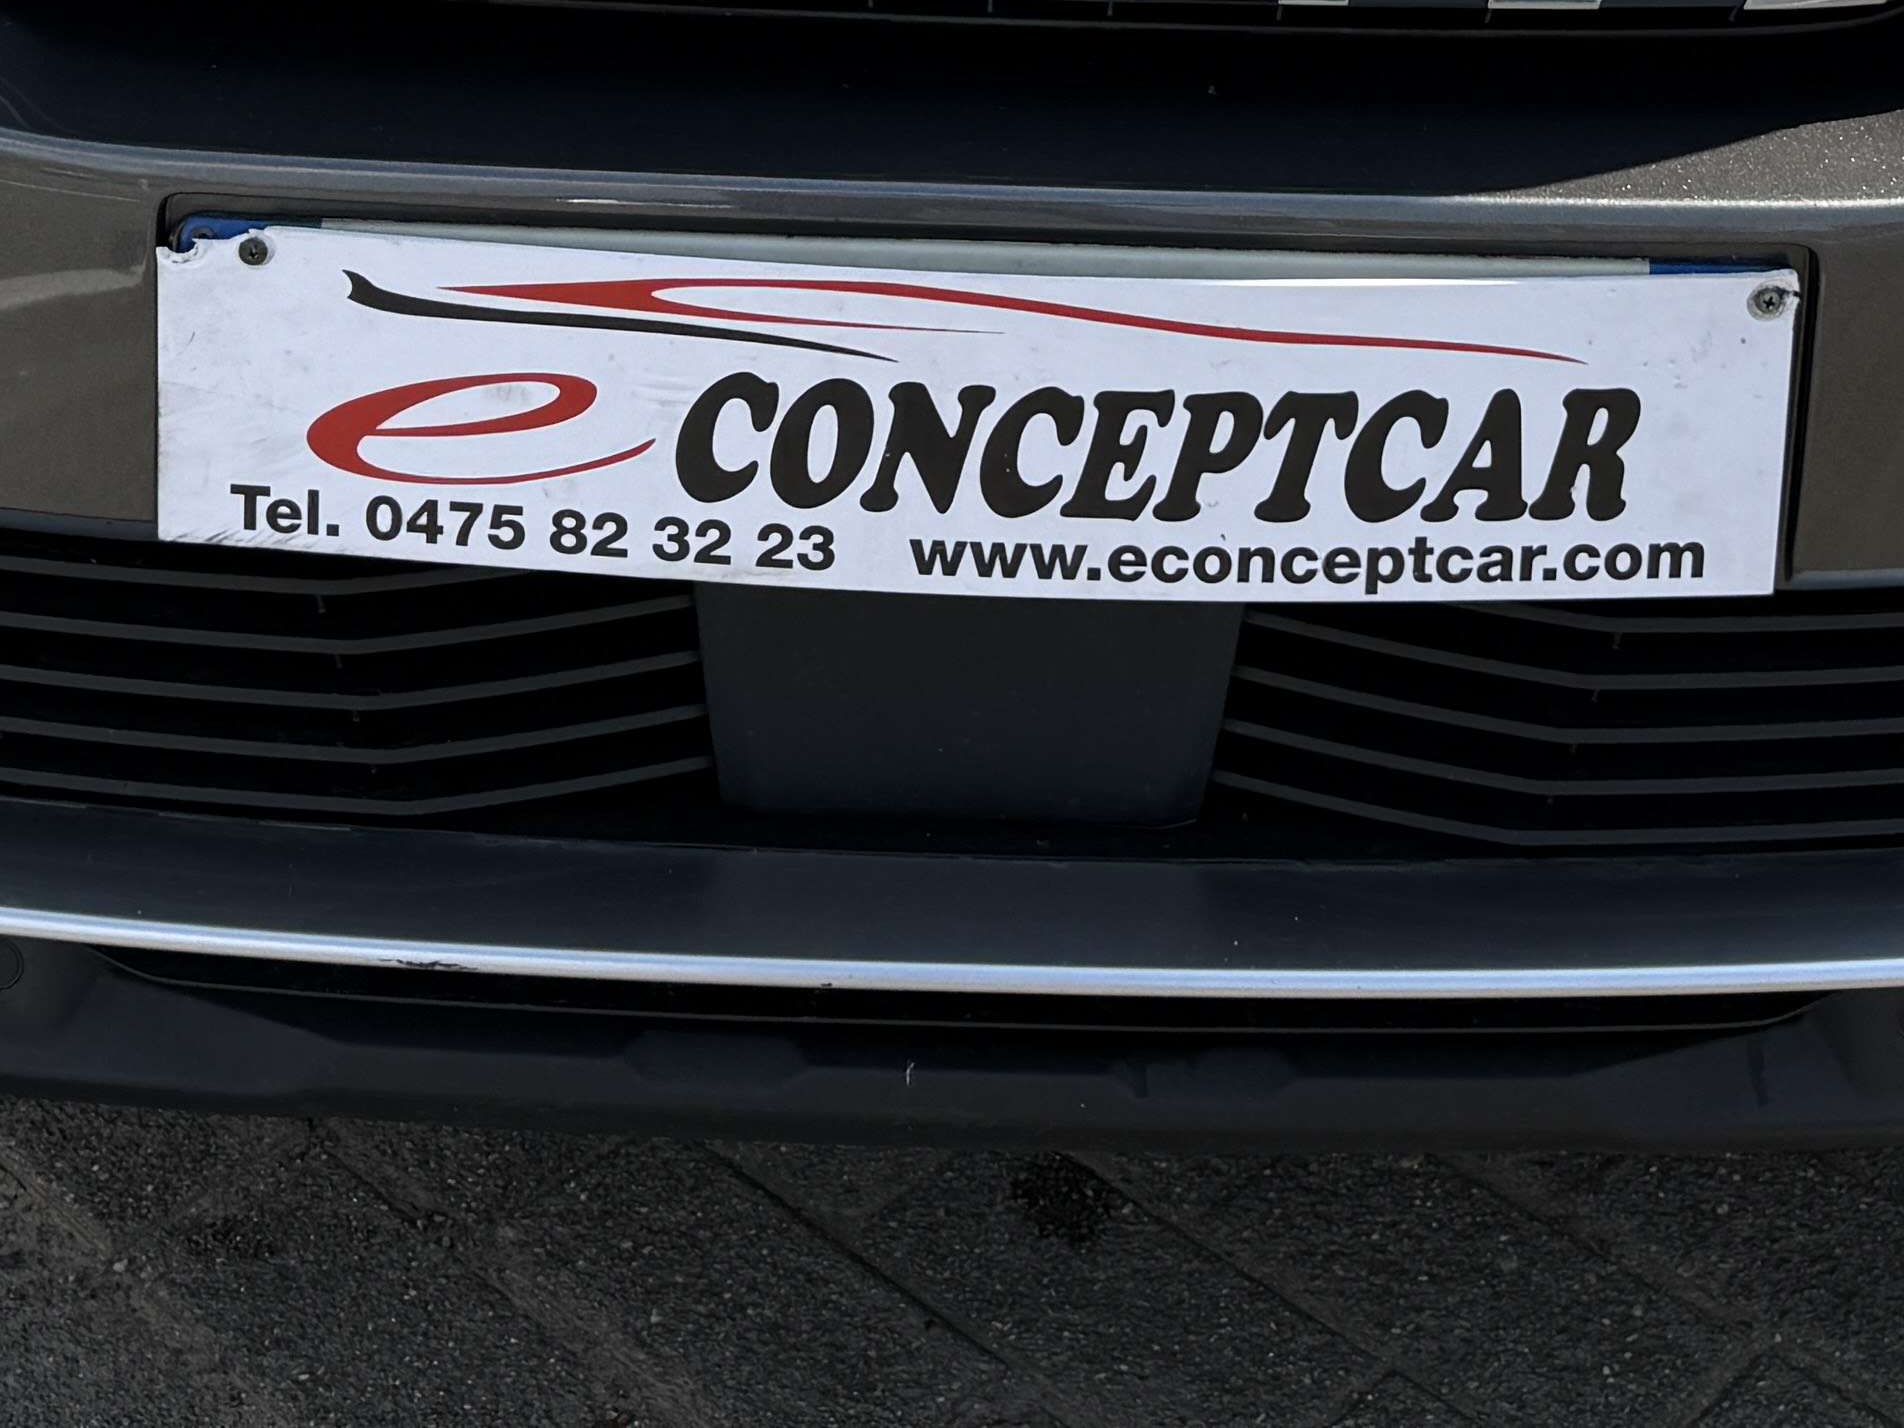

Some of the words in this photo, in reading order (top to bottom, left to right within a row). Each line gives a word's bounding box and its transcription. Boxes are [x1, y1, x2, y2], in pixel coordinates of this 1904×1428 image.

[307, 372, 656, 485] e
[675, 371, 1642, 523] CONCEPTCAR
[230, 483, 341, 537] Tel.
[365, 494, 526, 550] 0475
[549, 508, 628, 559] 82
[651, 516, 733, 565] 32
[755, 523, 836, 572] 23
[909, 536, 1706, 596] www.econceptcar.com
